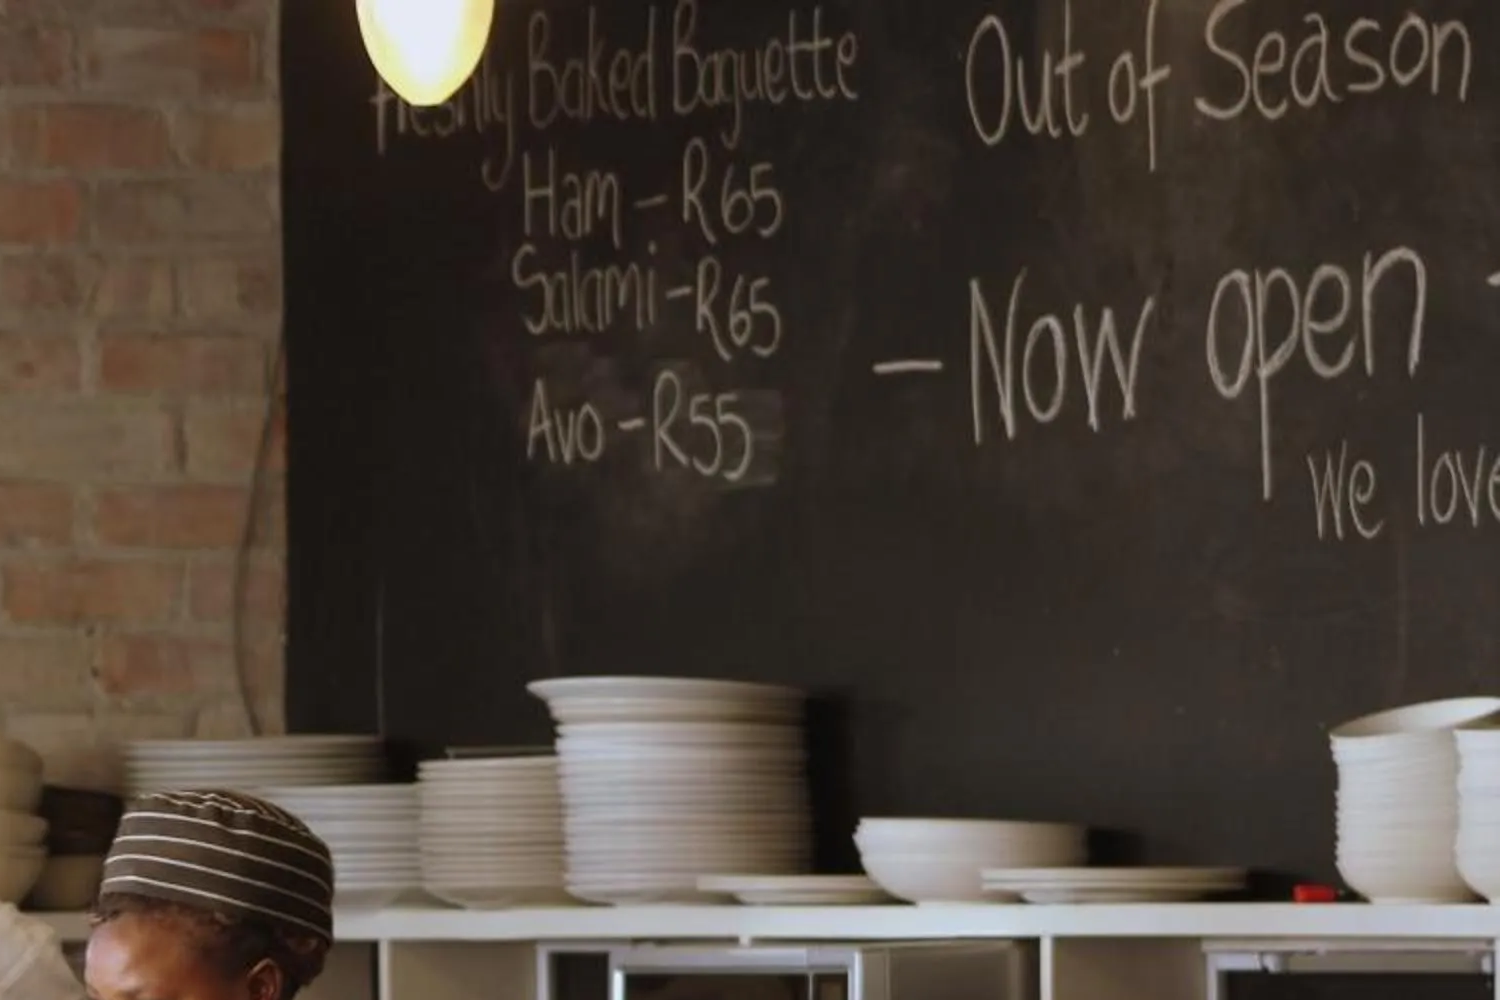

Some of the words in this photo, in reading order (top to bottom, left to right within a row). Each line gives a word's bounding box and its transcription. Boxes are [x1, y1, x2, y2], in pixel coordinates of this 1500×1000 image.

[528, 5, 656, 129] Baked
[673, 0, 858, 150] Baguette
[966, 0, 1088, 146] Out
[1108, 0, 1171, 172] of
[1195, 0, 1471, 120] Season
[523, 143, 620, 249] Ham
[682, 137, 782, 244] R65
[512, 240, 657, 336] Salami
[696, 254, 781, 362] R65
[526, 377, 602, 464] Avo
[653, 369, 752, 481] R55
[1206, 246, 1427, 501] open
